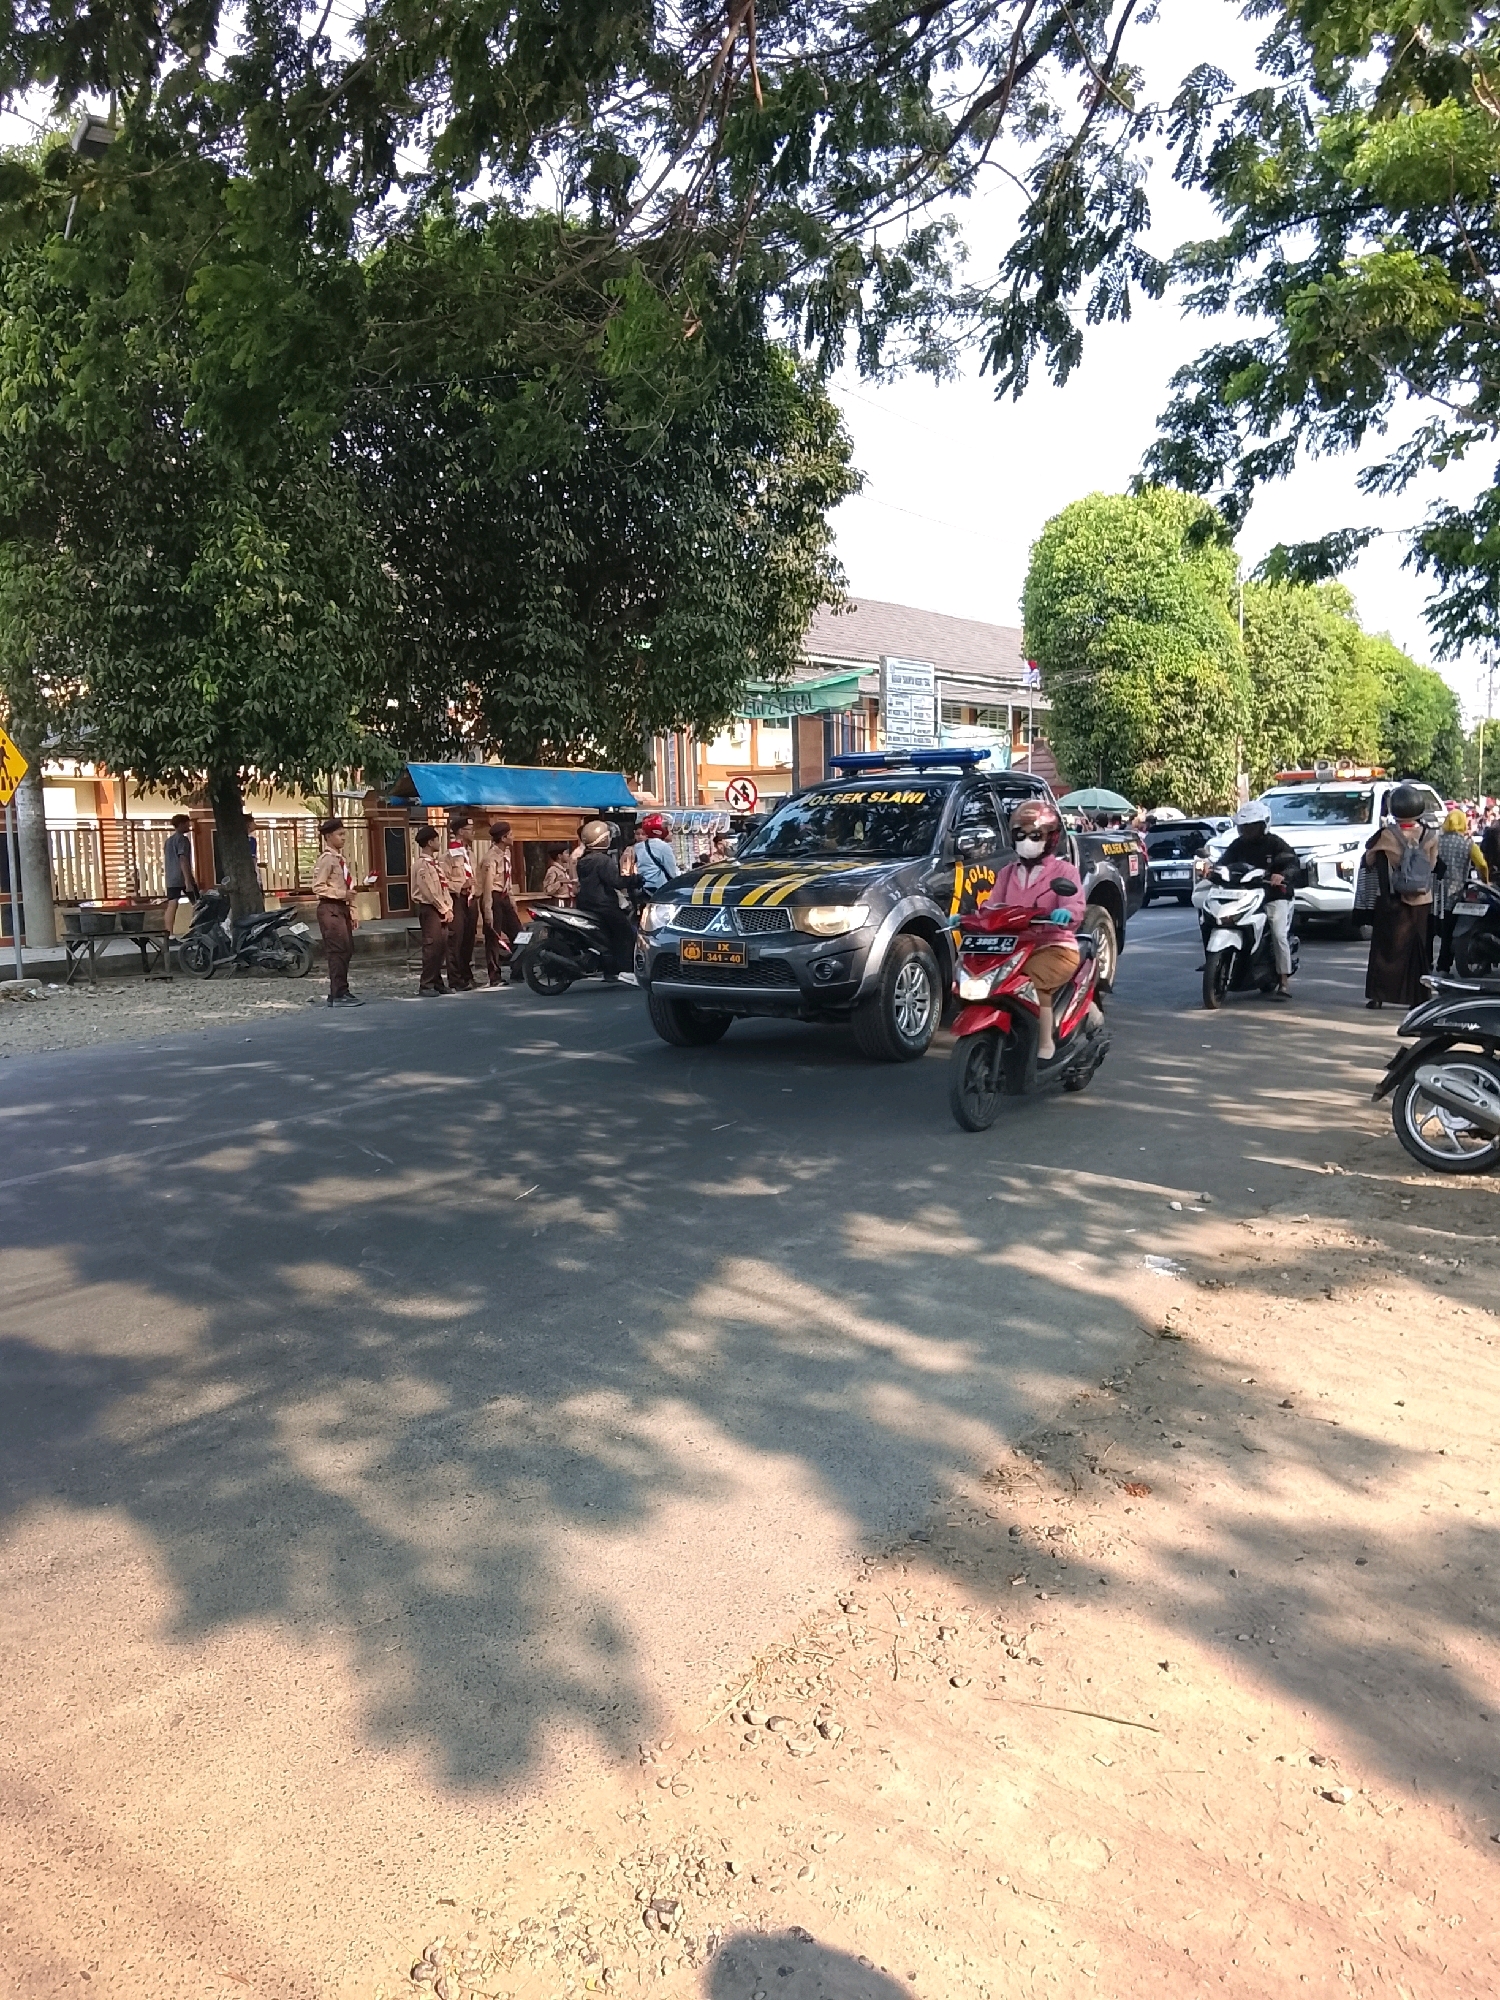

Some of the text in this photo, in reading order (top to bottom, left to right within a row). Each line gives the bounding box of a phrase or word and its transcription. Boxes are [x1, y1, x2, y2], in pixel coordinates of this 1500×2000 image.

[867, 791, 926, 804] SLAWI
[964, 865, 996, 895] POLIS
[717, 943, 730, 951] IX
